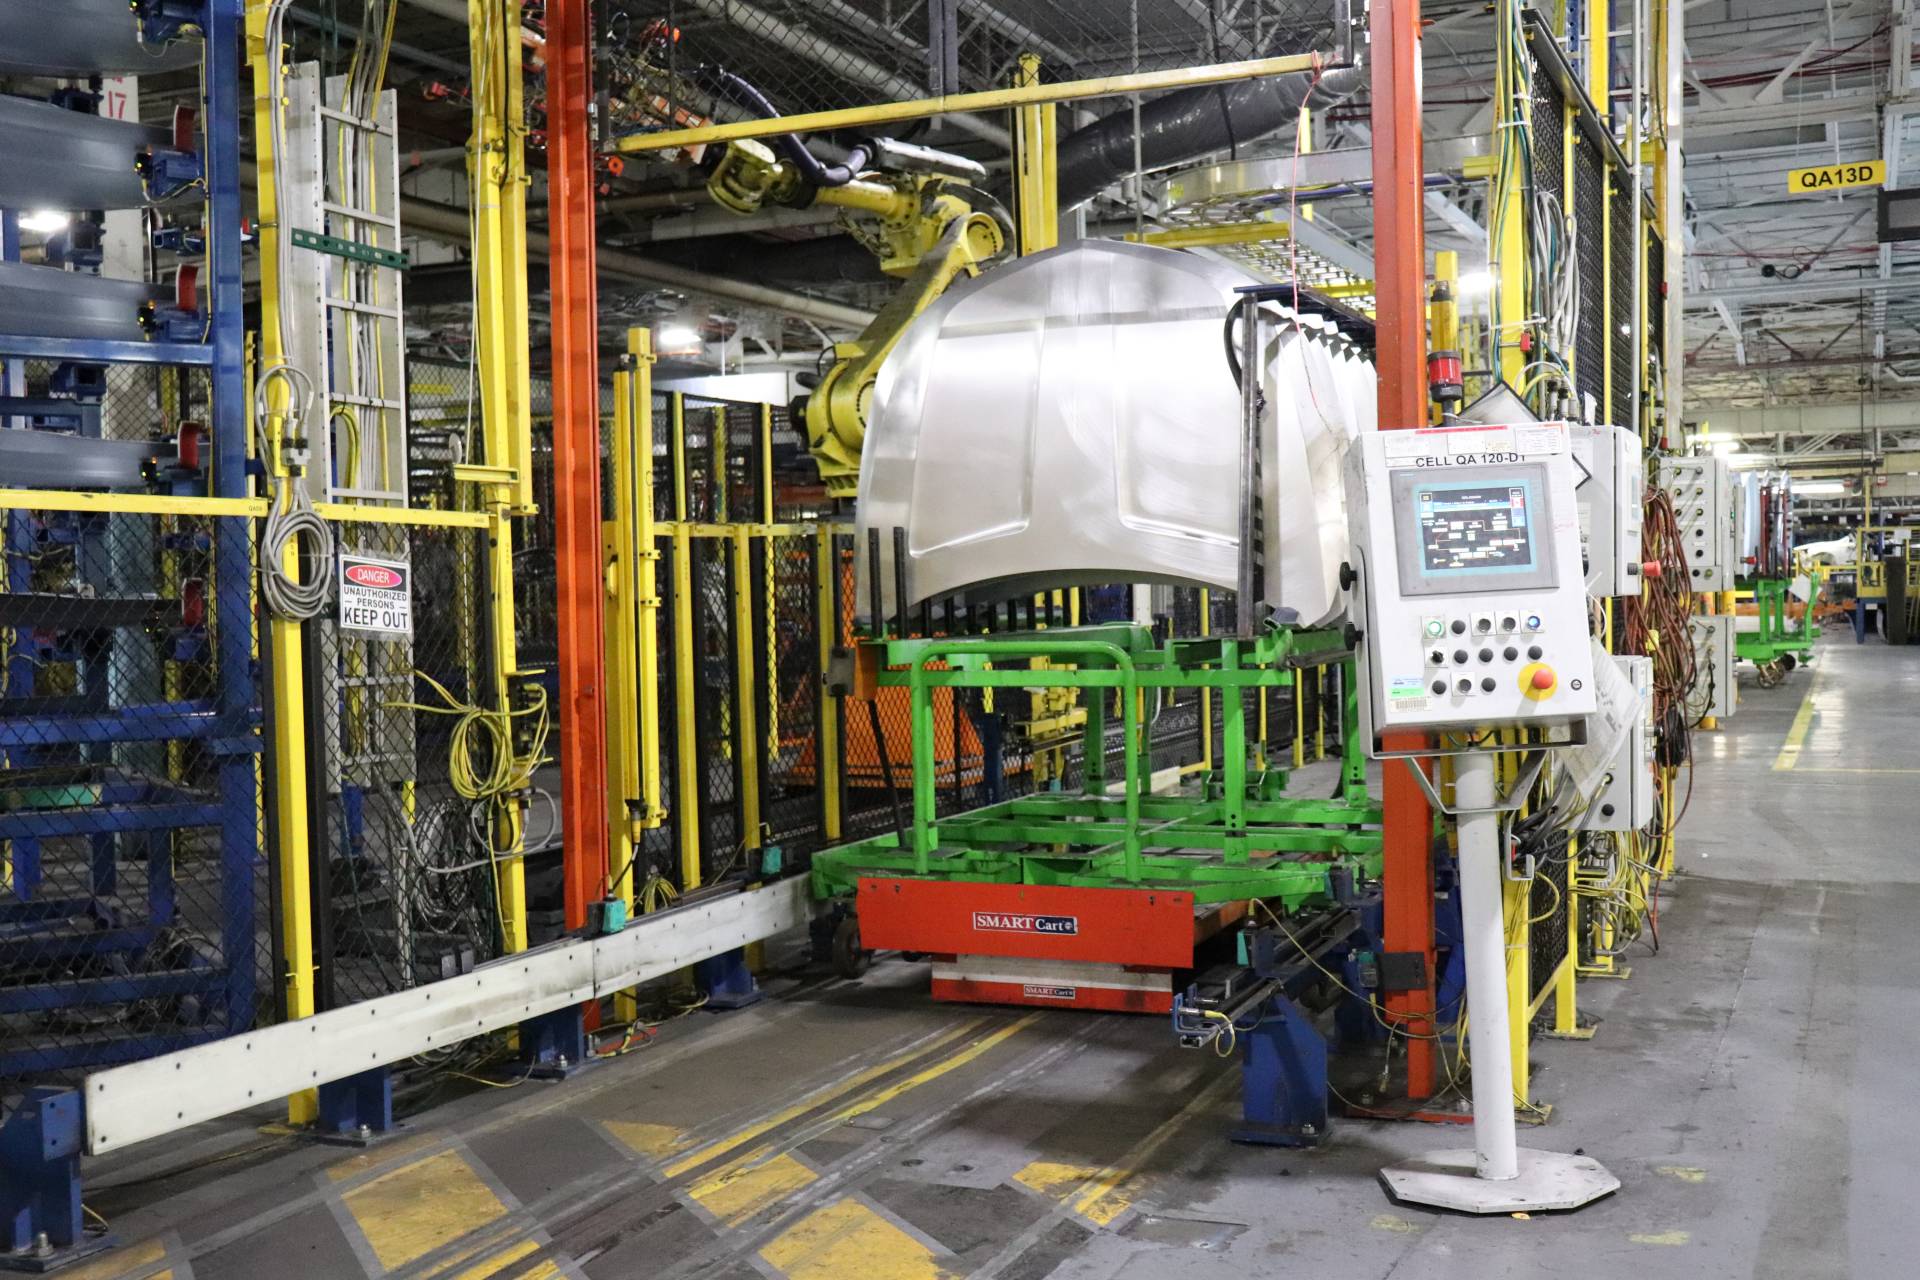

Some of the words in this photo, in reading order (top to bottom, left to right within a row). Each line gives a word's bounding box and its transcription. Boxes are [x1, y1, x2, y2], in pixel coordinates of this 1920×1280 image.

[108, 90, 127, 119] 17
[1801, 166, 1873, 188] QA13D
[1415, 456, 1452, 467] CELL
[1456, 454, 1477, 465] QA
[1481, 452, 1526, 463] 120-D1
[357, 568, 390, 584] DANGER
[344, 586, 407, 601] UNAUTHORIZED
[357, 597, 395, 610] PERSONS
[344, 608, 378, 626] KEEP
[383, 611, 408, 629] OUT
[977, 915, 1034, 929] SMART
[1035, 918, 1063, 931] Cart
[1025, 986, 1053, 995] SMART
